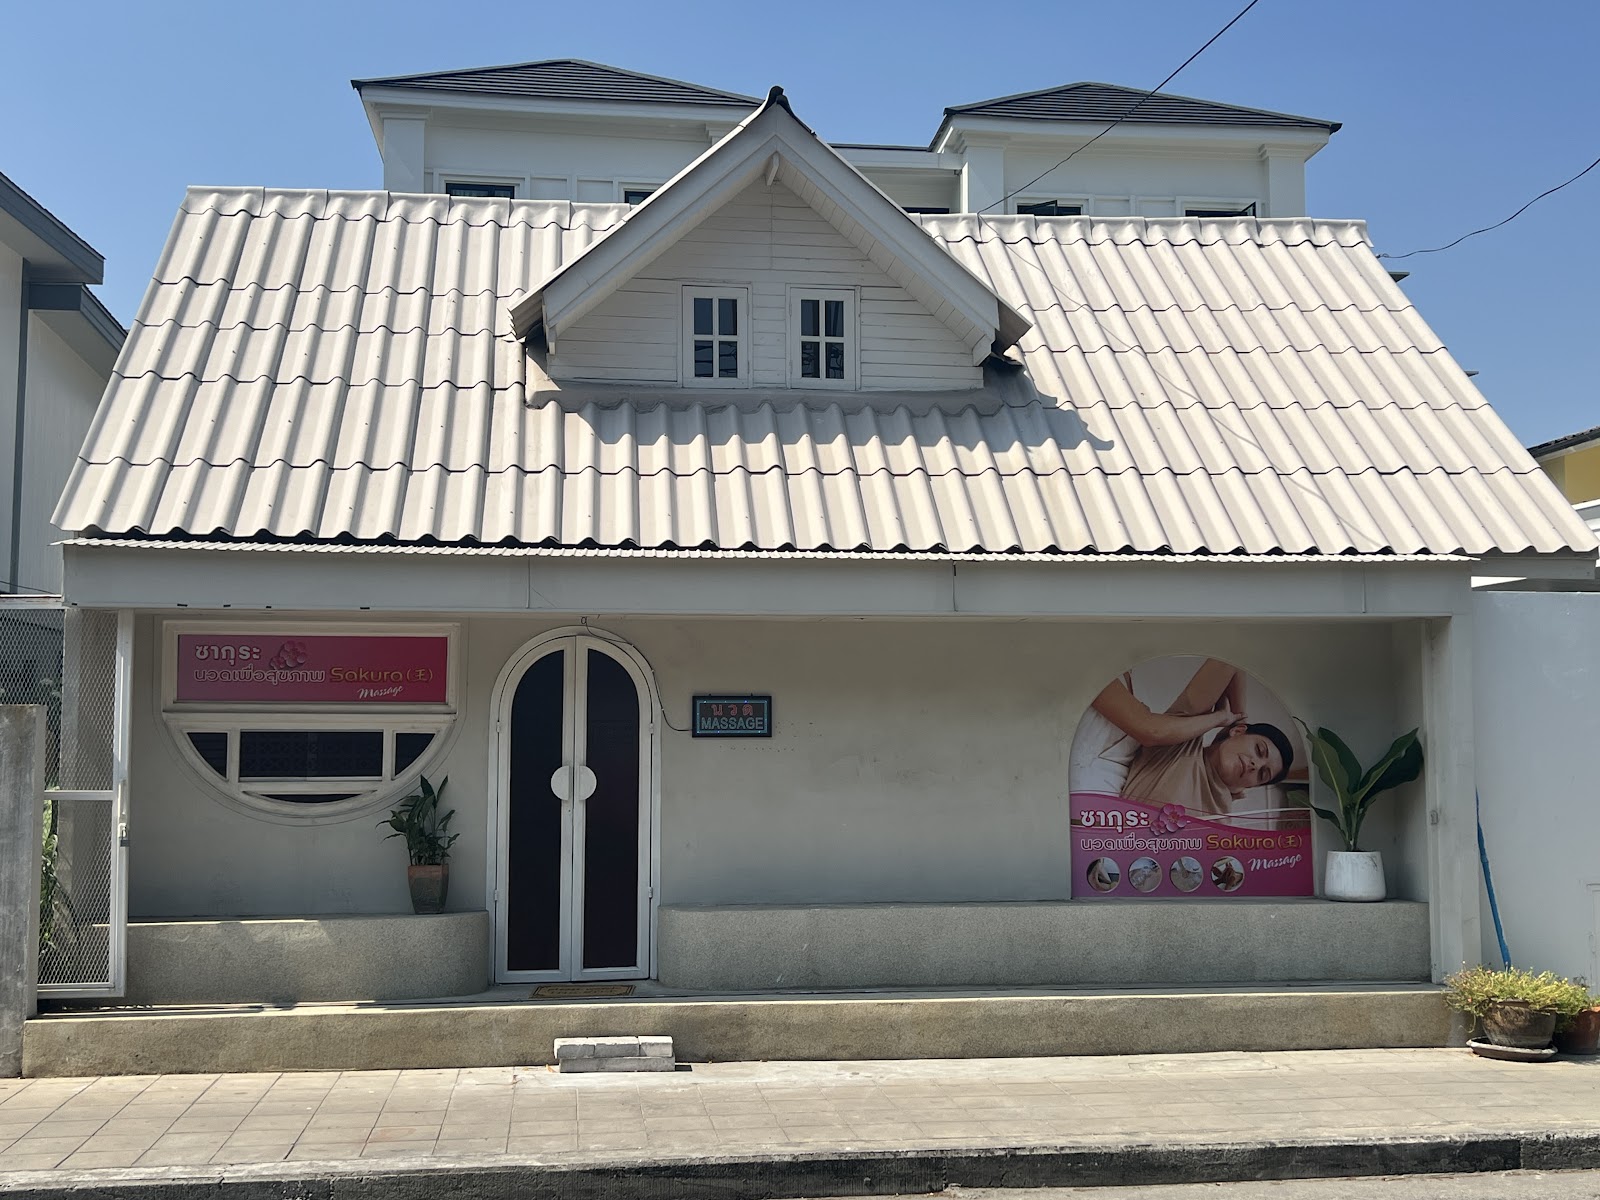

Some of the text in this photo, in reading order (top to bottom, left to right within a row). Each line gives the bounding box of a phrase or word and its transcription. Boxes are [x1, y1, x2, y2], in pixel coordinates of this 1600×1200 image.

[358, 685, 403, 700] Massage
[701, 717, 764, 730] MASSAGE
[1248, 854, 1303, 872] Massage
